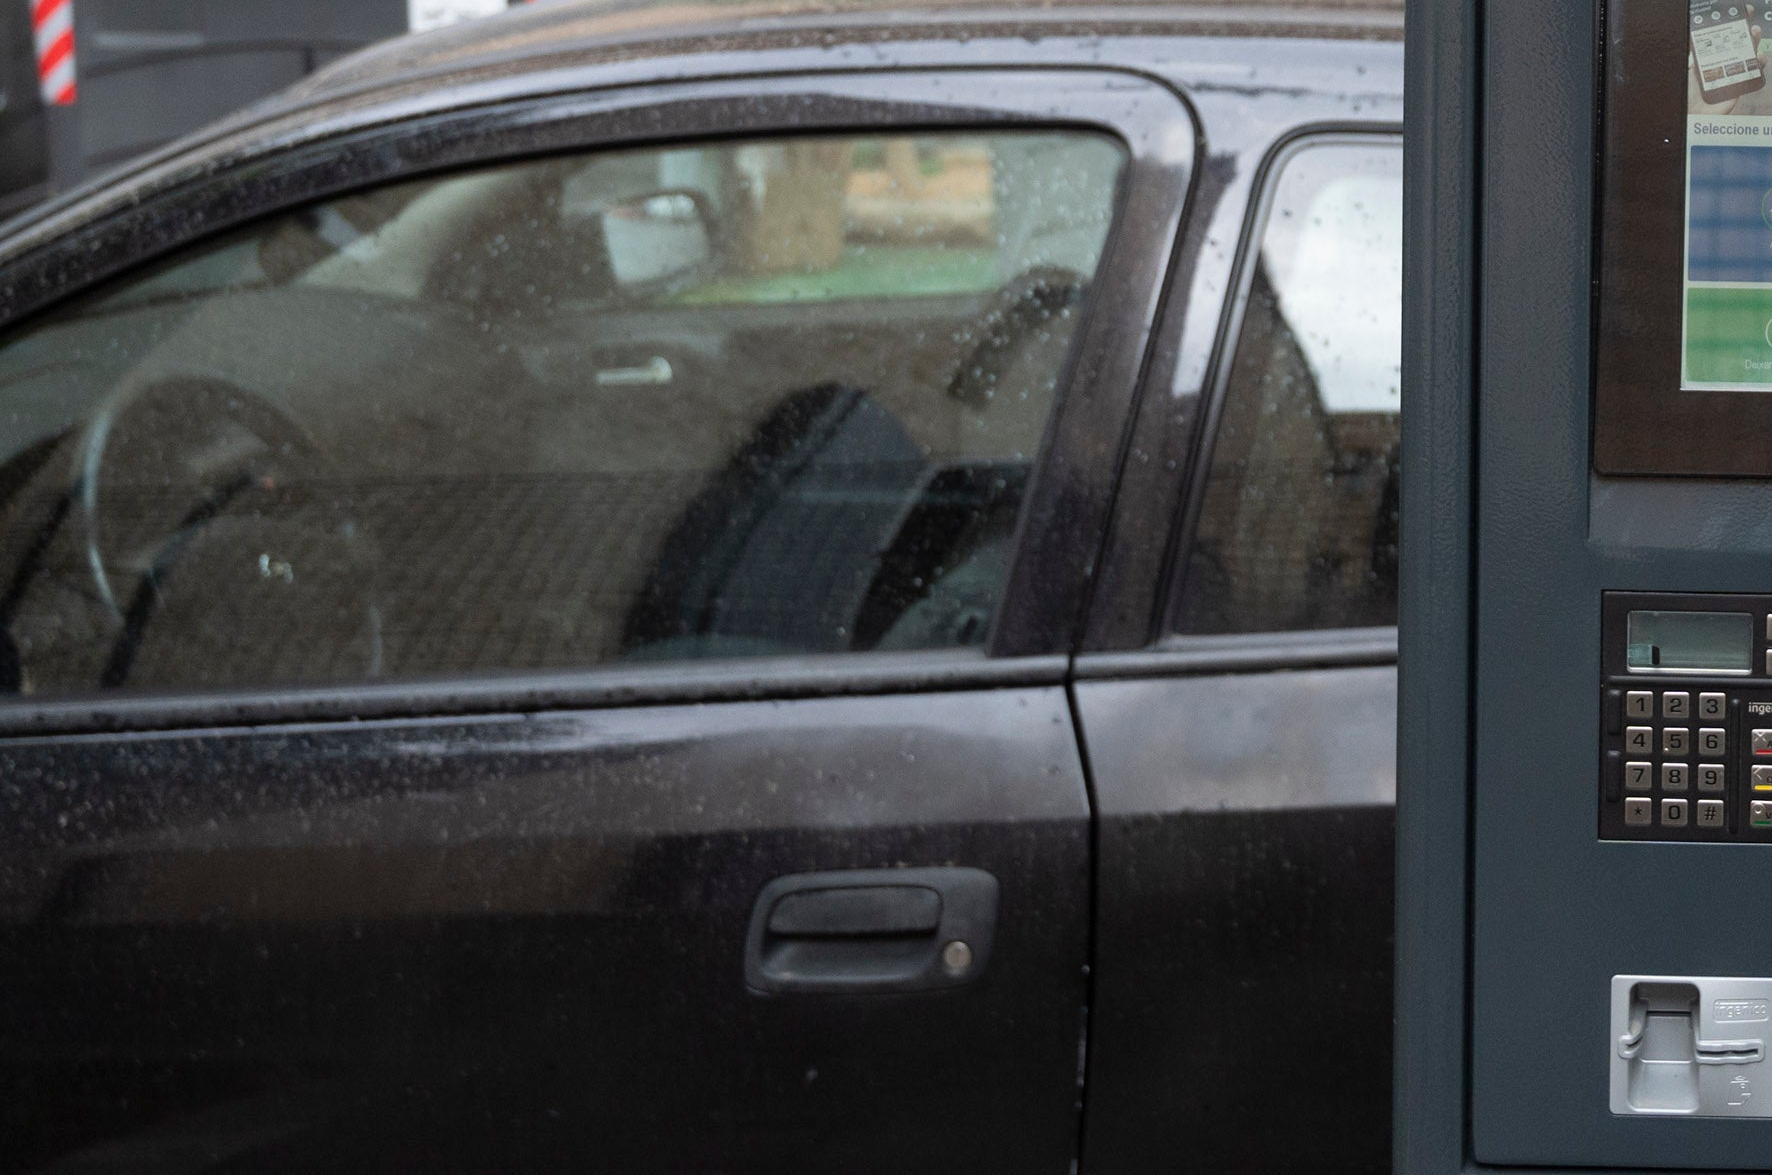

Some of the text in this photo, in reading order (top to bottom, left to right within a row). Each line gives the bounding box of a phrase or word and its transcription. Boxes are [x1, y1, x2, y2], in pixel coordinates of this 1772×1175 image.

[1694, 123, 1760, 136] Seleccione
[1636, 697, 1645, 712] 1
[1669, 697, 1683, 713] 2
[1705, 698, 1719, 714] 3
[1632, 733, 1646, 748] 4
[1669, 733, 1682, 749] 5
[1705, 734, 1719, 750] 6
[1632, 768, 1645, 784] 7
[1668, 769, 1682, 785] 8
[1704, 770, 1718, 786] 9
[1667, 805, 1681, 820] 0
